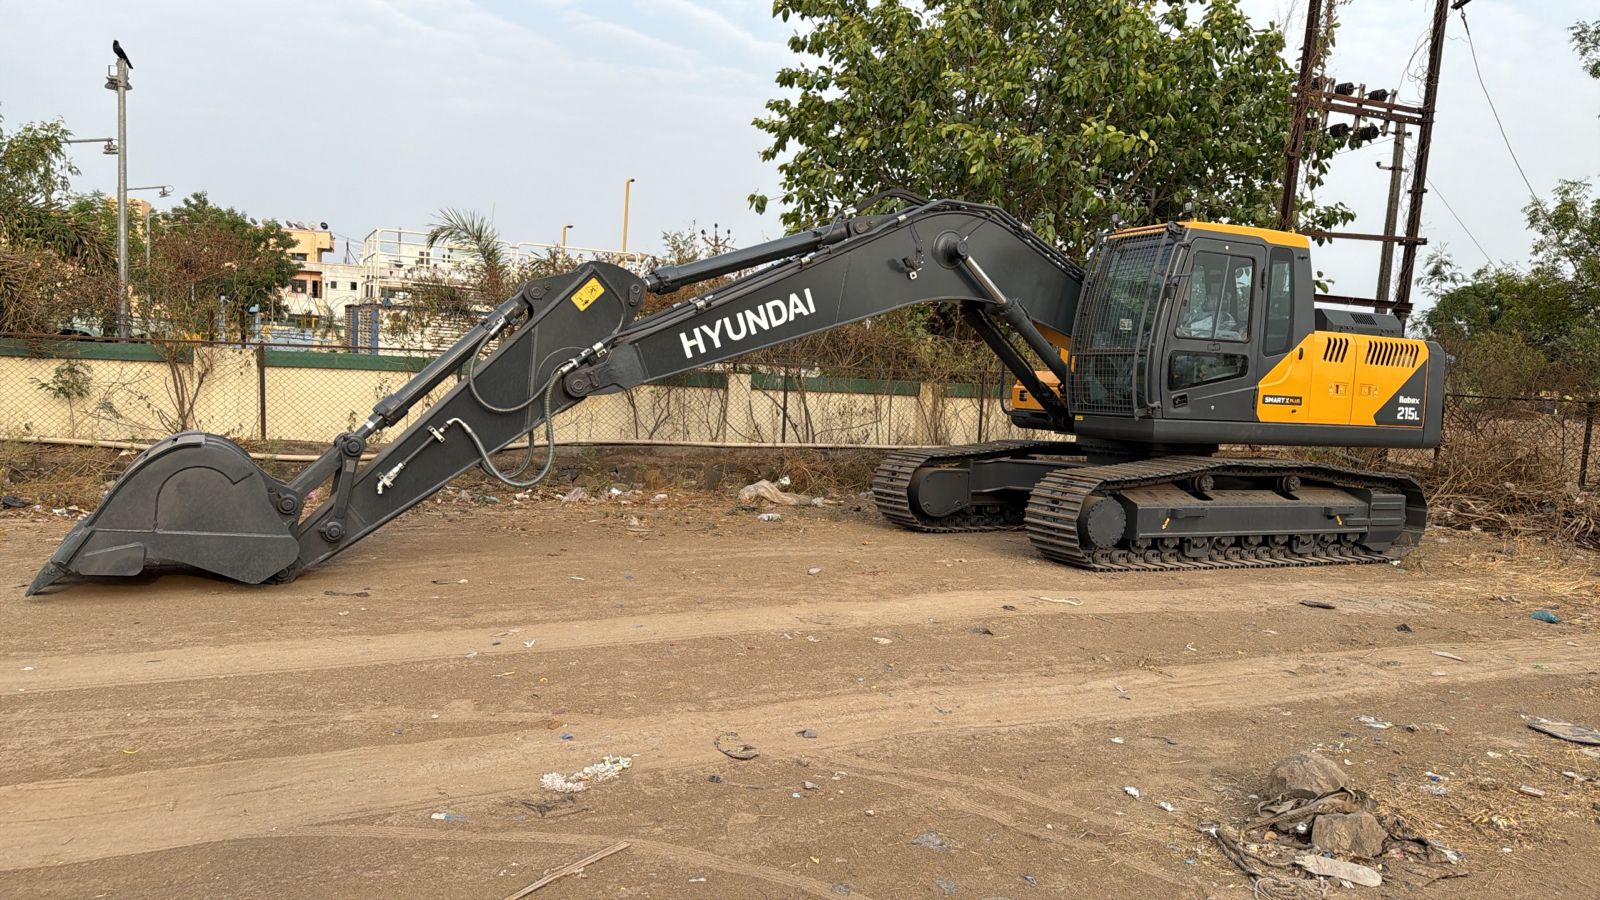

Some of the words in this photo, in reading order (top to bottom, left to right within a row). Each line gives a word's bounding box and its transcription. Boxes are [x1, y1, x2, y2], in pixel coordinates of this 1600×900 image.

[679, 288, 816, 359] HYUNDAI
[1264, 396, 1285, 404] SMART
[1399, 396, 1420, 404] Robex
[1397, 407, 1420, 420] 215L
